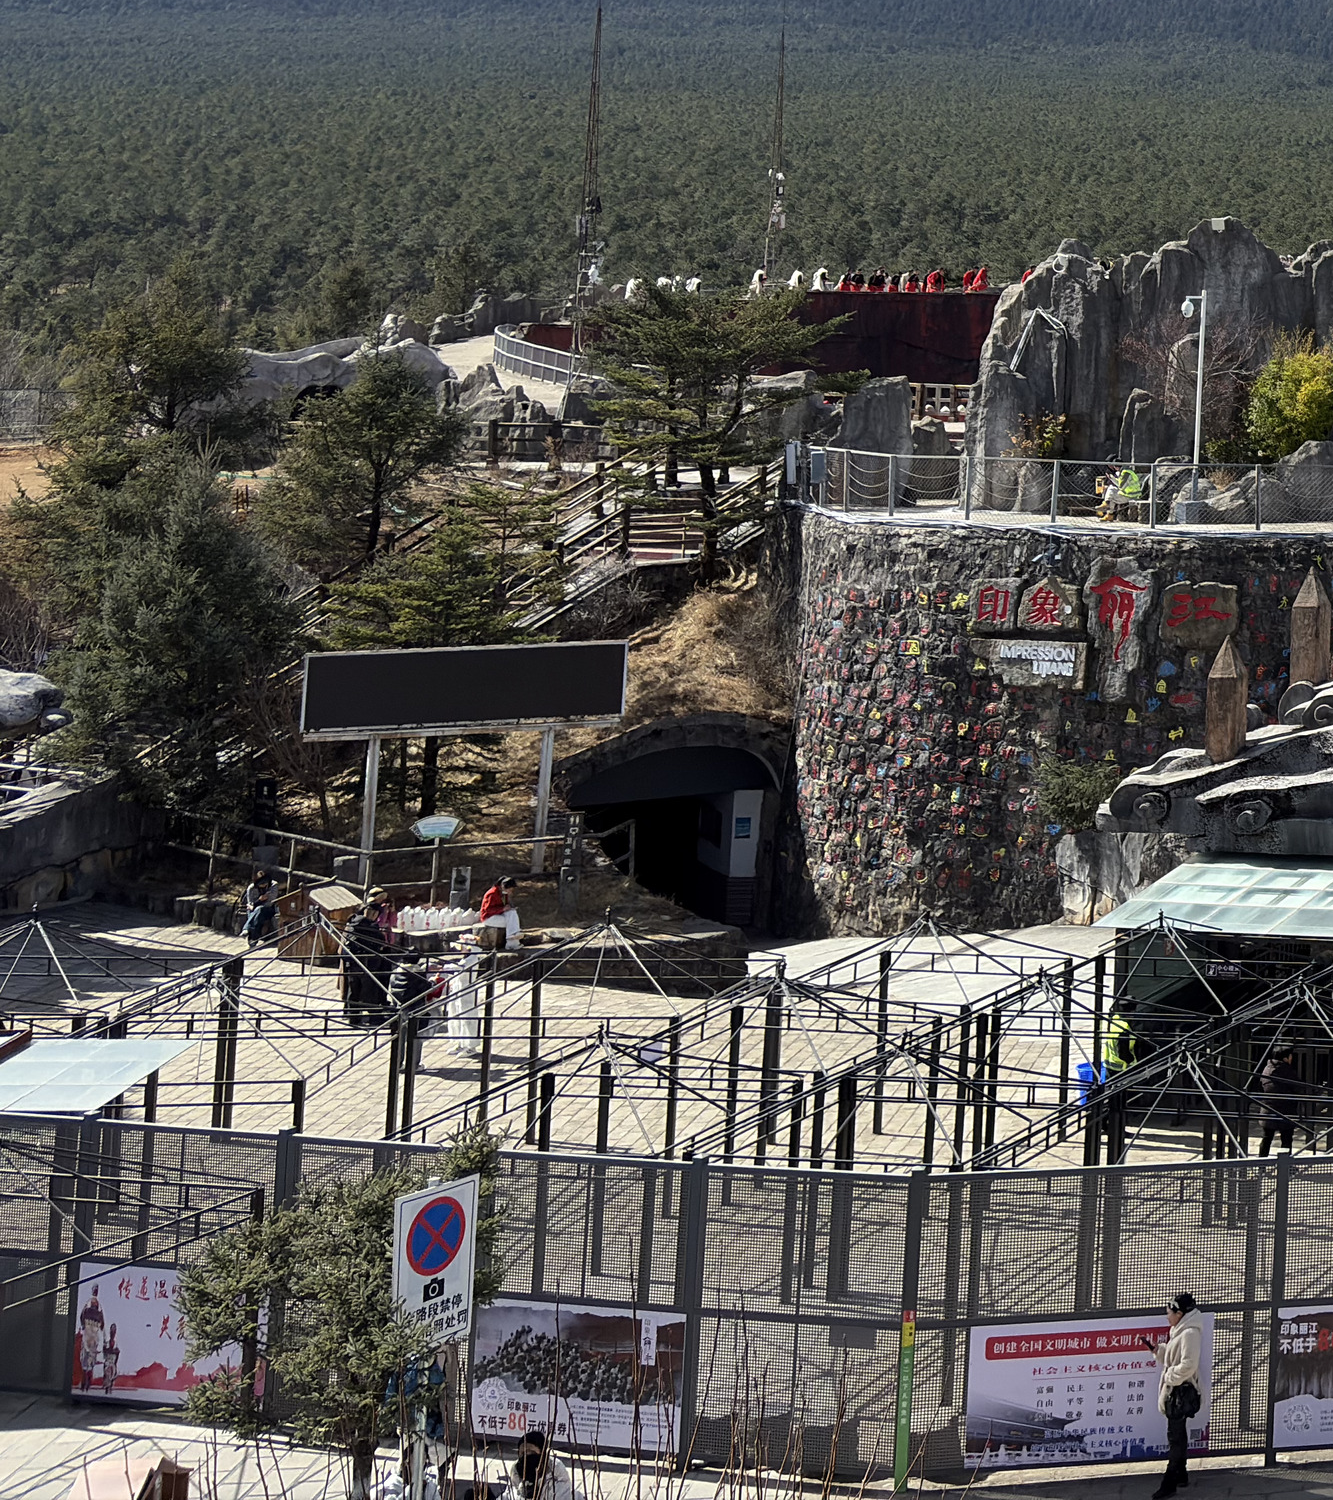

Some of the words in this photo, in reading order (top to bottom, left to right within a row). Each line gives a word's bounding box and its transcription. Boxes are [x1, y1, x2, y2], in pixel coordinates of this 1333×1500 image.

[977, 576, 1232, 662] 印象丽江
[1000, 644, 1076, 662] IMPRESSION
[1280, 1322, 1318, 1336] 印象丽江
[993, 1337, 1092, 1355] 创建全国文明城市
[1032, 1360, 1157, 1376] 社会主义核心价值观
[1036, 1385, 1054, 1395] 富强
[1066, 1384, 1085, 1393] 民主
[1097, 1382, 1115, 1391] 文明
[1128, 1380, 1145, 1389] 和谐
[507, 1399, 537, 1414] 印象丽江
[1037, 1399, 1054, 1408] 自由
[1067, 1397, 1084, 1405] 平等
[1097, 1396, 1115, 1404] 公正
